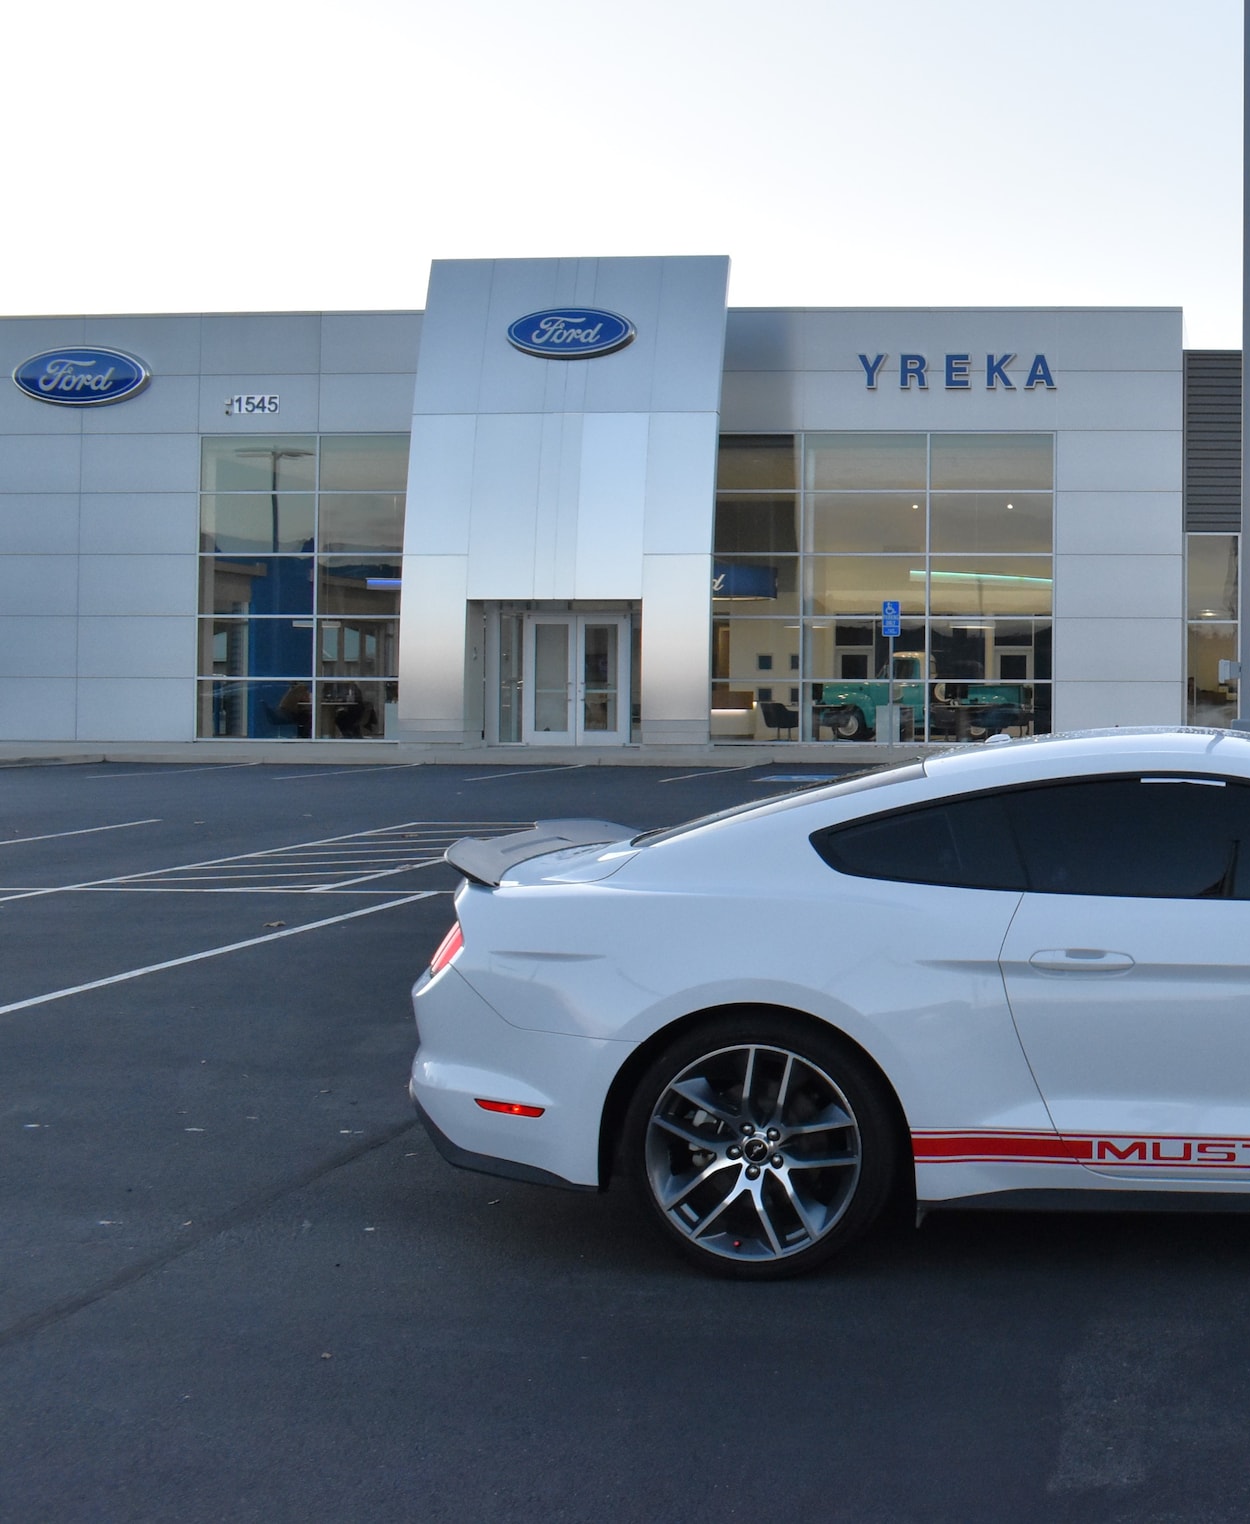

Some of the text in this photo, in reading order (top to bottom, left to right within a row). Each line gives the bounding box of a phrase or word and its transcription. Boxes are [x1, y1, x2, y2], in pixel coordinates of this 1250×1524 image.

[531, 316, 603, 344] Ford
[38, 359, 116, 391] Ford
[857, 353, 1057, 389] YREKA
[234, 396, 279, 413] 1545
